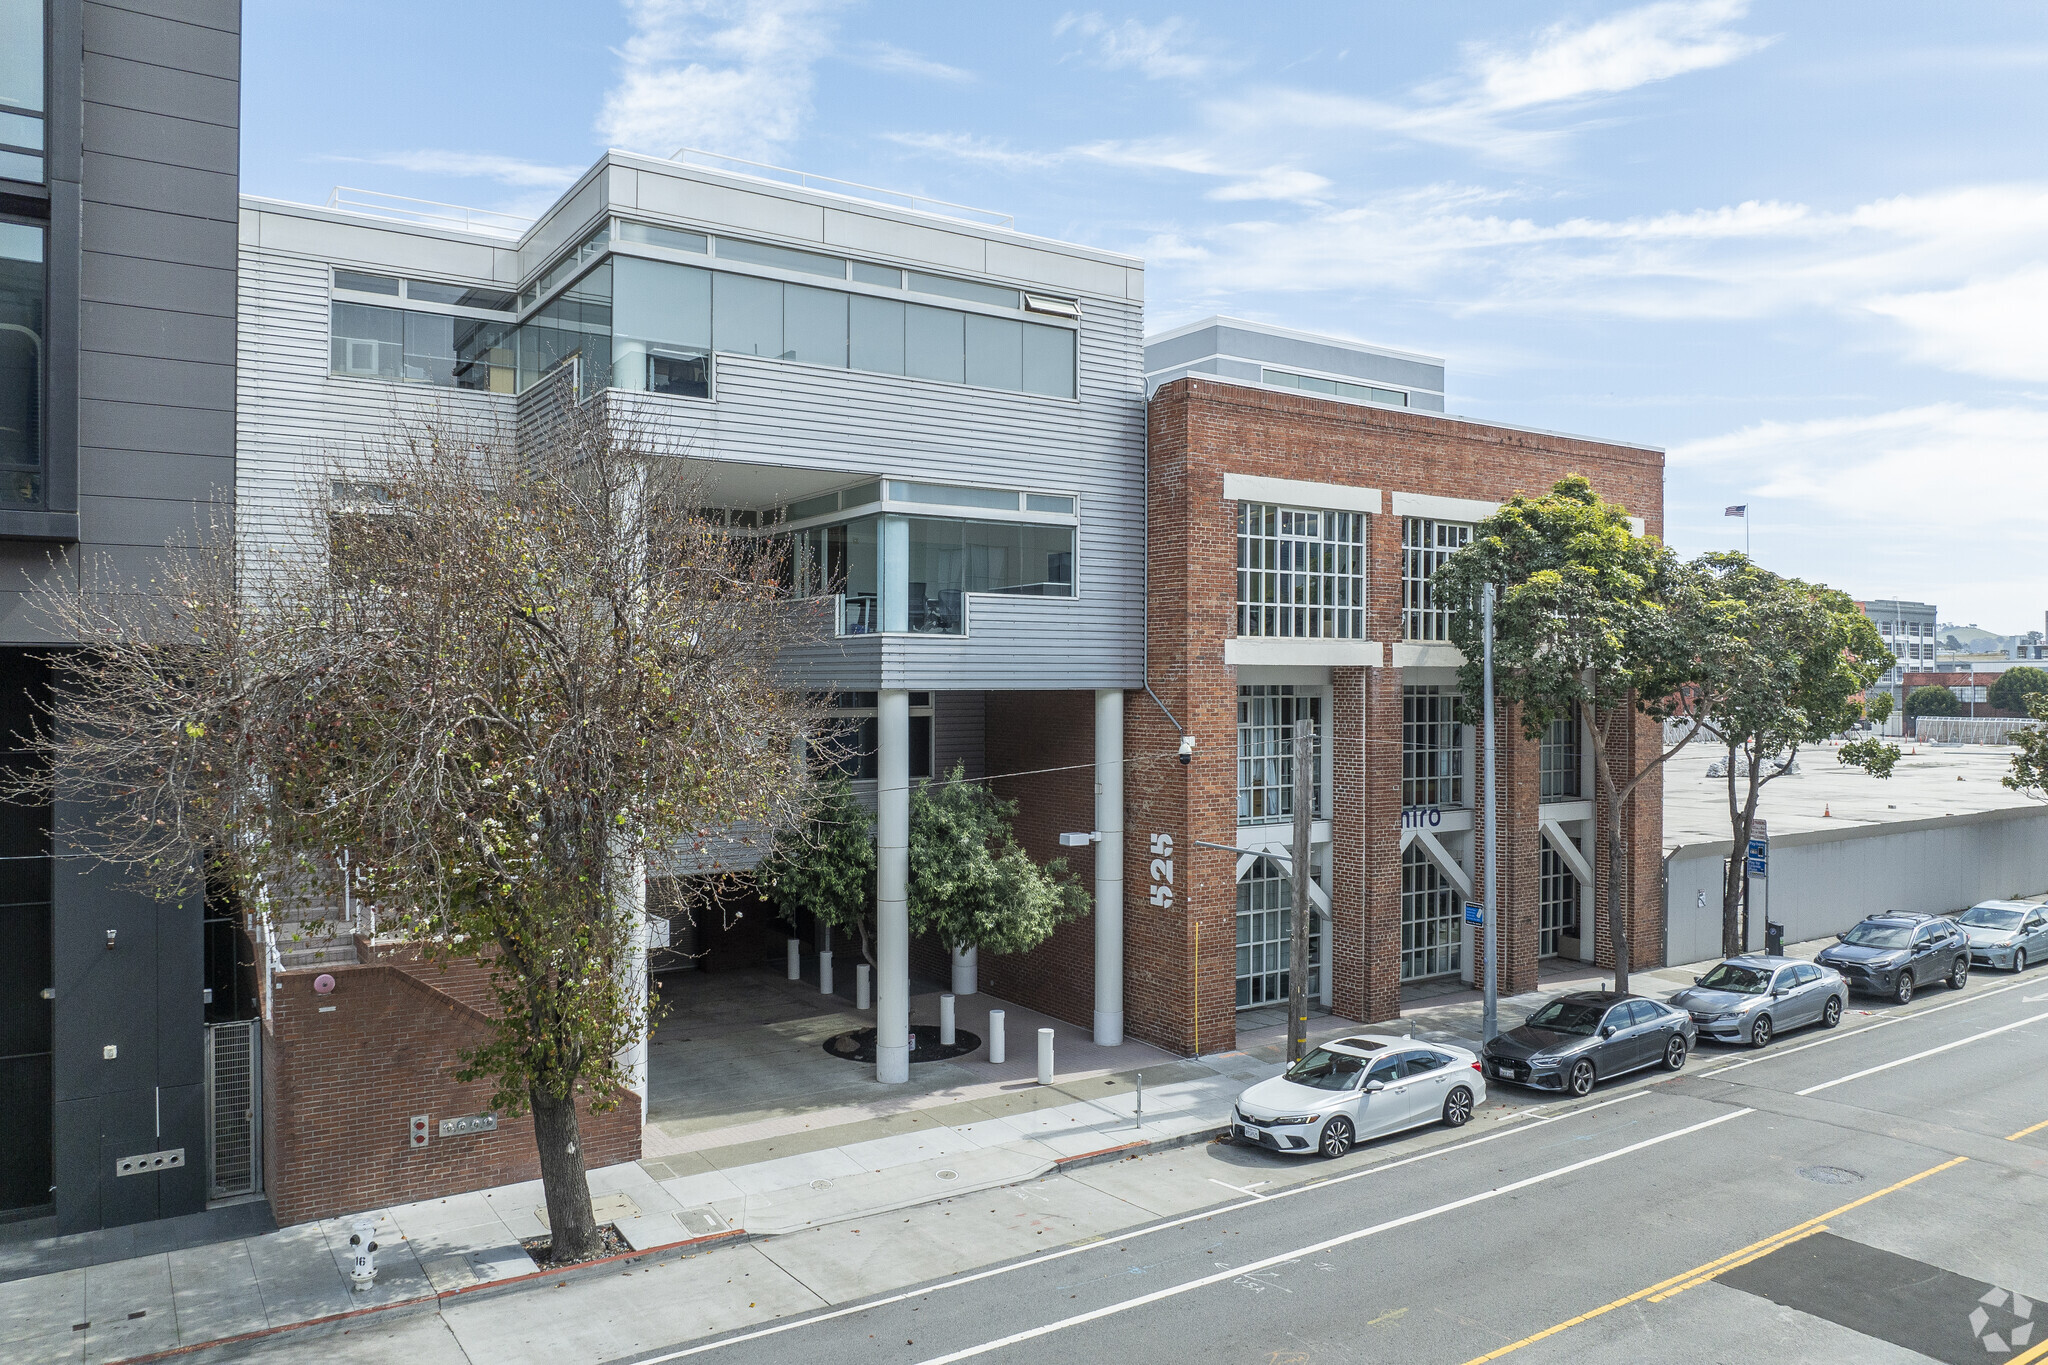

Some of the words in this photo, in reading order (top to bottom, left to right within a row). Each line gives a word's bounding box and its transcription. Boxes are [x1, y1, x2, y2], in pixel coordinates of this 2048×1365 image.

[1150, 833, 1174, 909] 525
[355, 1256, 366, 1266] 16
[1233, 1278, 1265, 1294] USA
